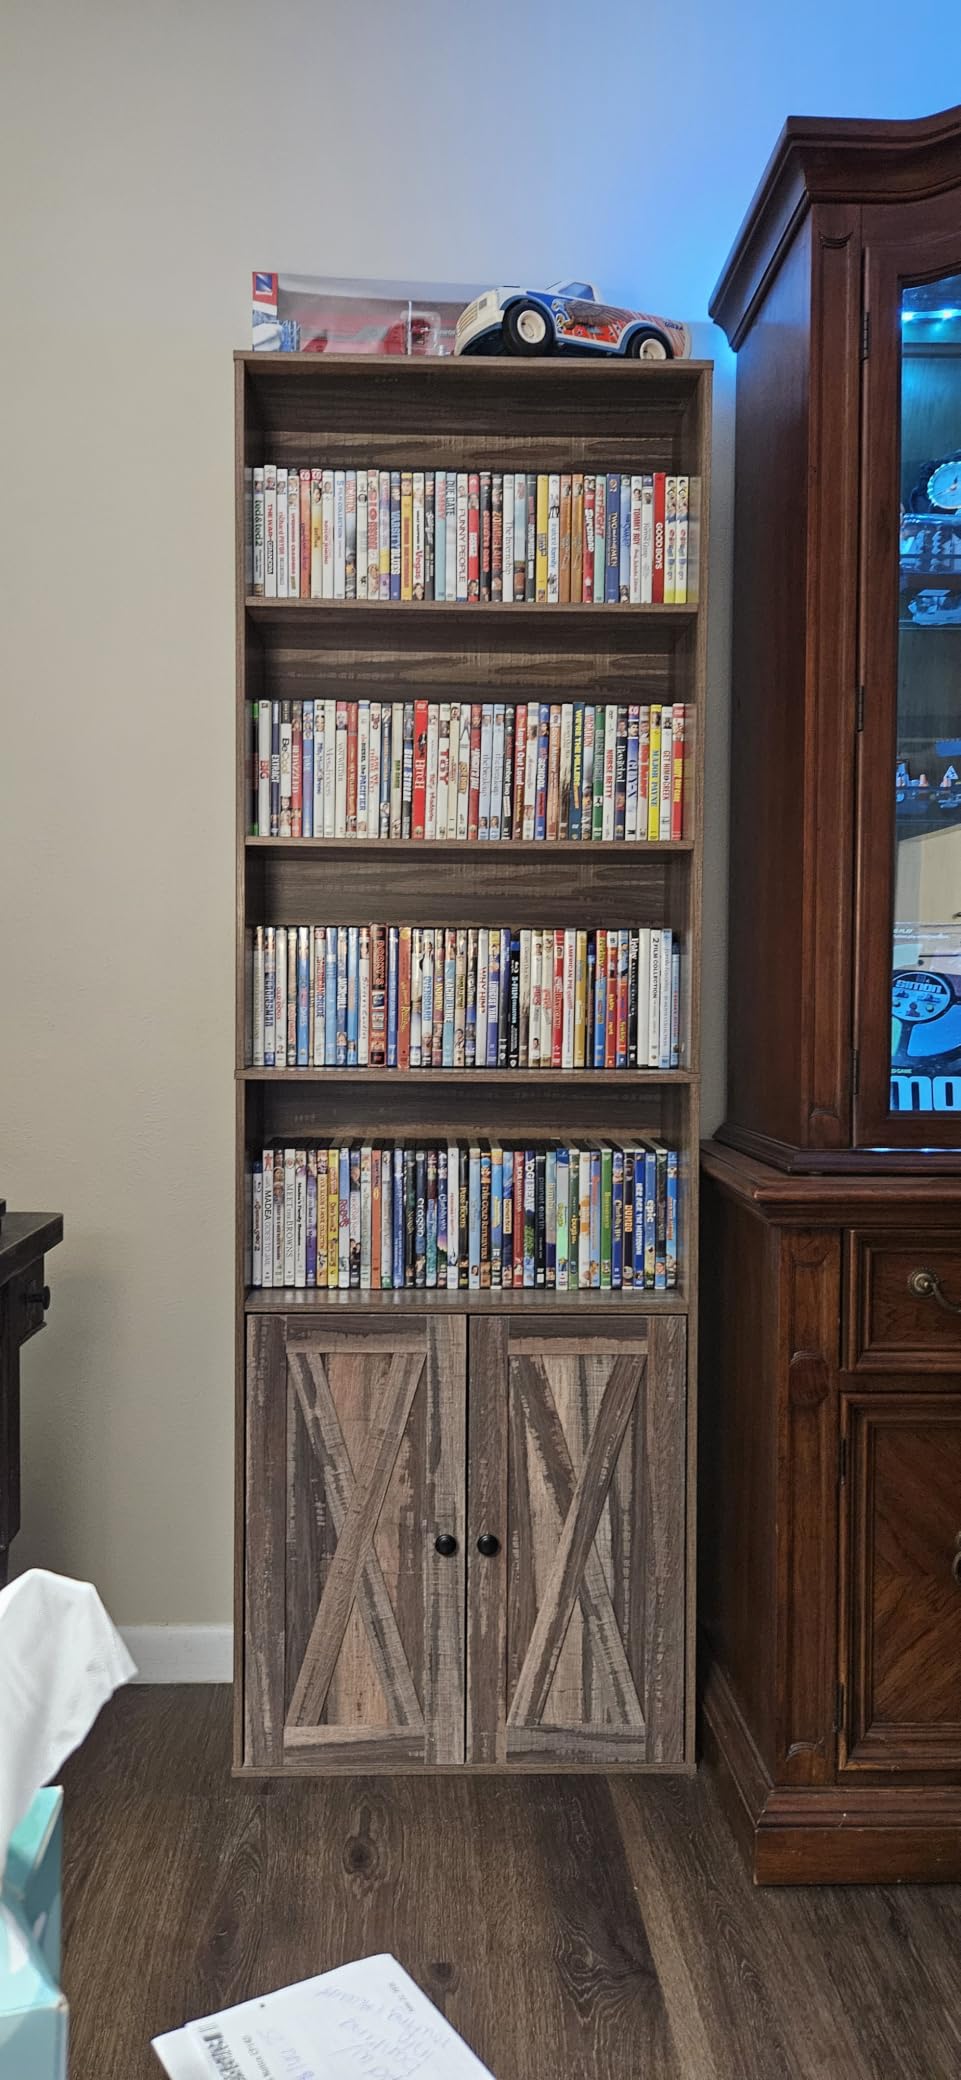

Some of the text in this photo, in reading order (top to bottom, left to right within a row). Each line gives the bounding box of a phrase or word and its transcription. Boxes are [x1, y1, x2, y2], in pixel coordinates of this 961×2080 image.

[655, 522, 663, 547] GOOD
[516, 728, 525, 750] Laugh
[574, 738, 582, 754] THE
[260, 760, 270, 780] BIG
[271, 754, 280, 783] EXTRACT
[415, 760, 425, 789] HITCH
[537, 758, 545, 790] SCHOOL
[525, 1159, 534, 1183] YOGI
[415, 1198, 424, 1237] eragon
[646, 1200, 655, 1222] epic
[481, 1221, 489, 1259] RETRIEVERS
